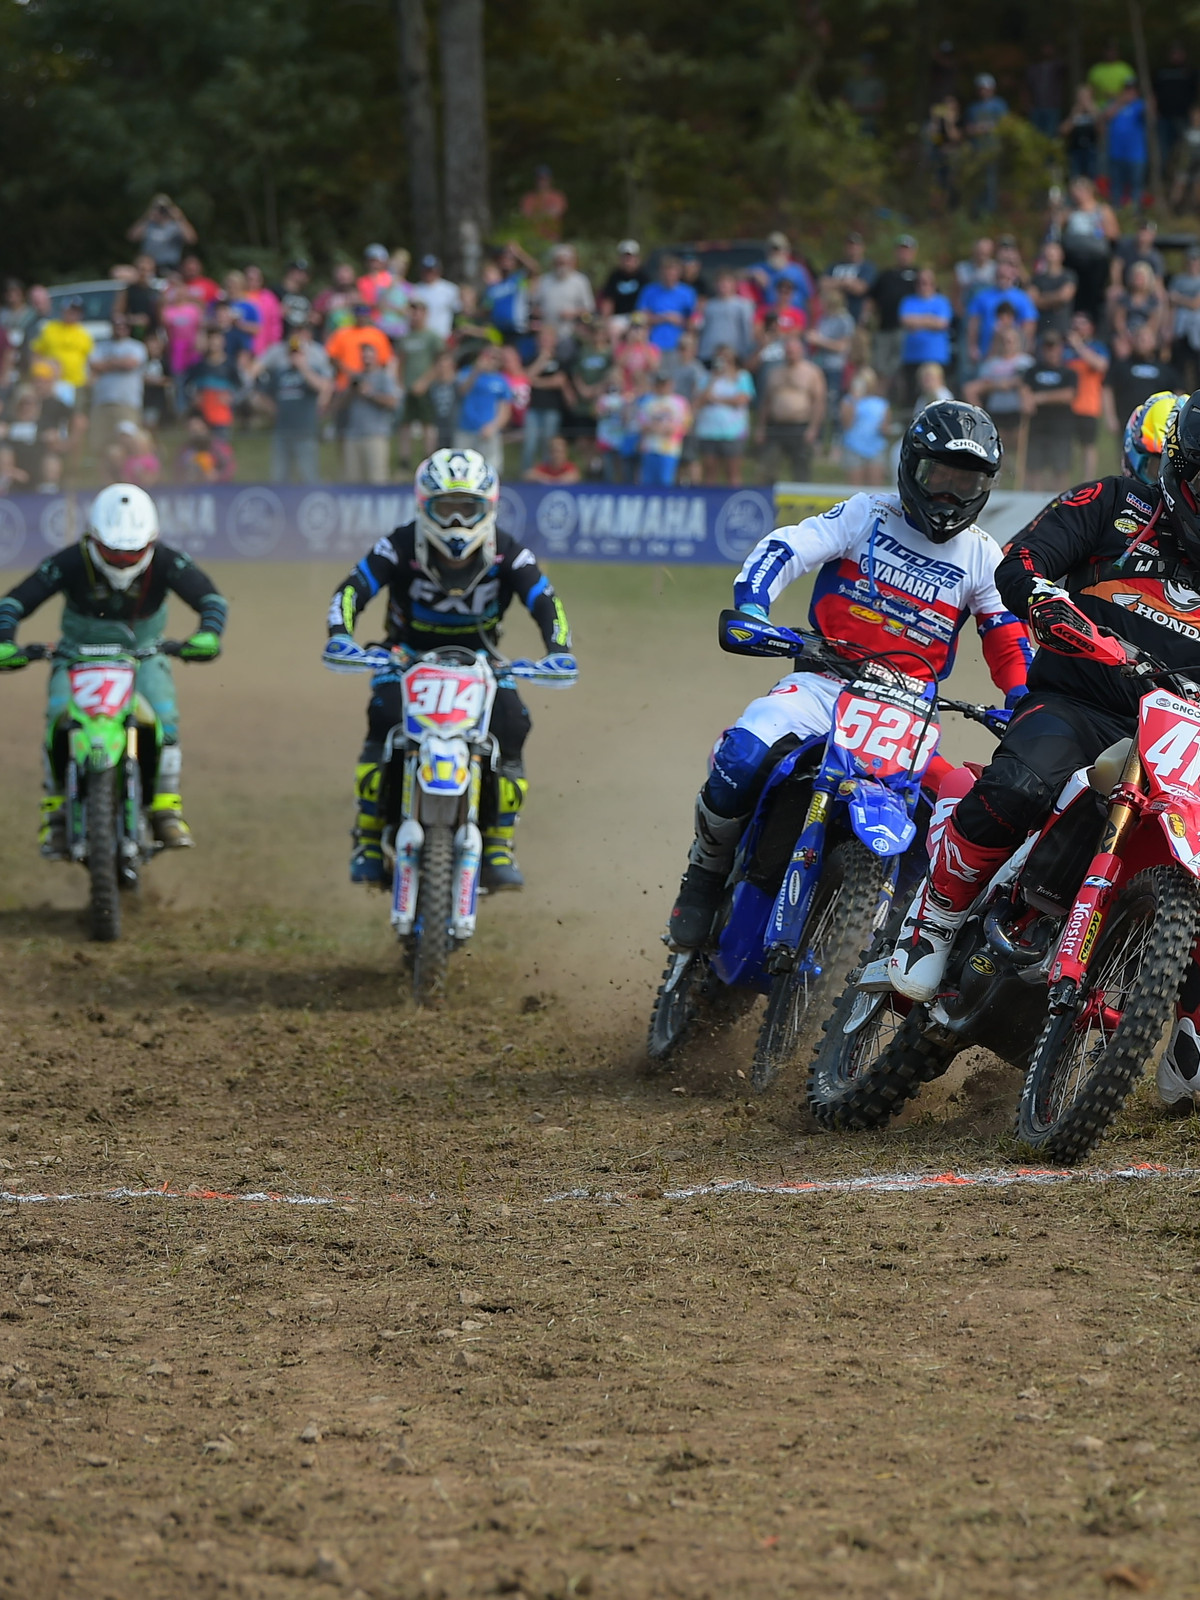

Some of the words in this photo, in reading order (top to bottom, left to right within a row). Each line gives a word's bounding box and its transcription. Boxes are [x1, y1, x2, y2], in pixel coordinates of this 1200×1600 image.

[953, 440, 983, 453] SHOEI
[577, 494, 707, 542] YAMAHA
[867, 530, 968, 582] MOOSE
[874, 560, 938, 604] YAMAHA
[901, 563, 961, 590] RACING
[767, 639, 791, 649] CYCRA
[1054, 627, 1096, 653] ACERBIS
[71, 669, 134, 709] 27
[407, 678, 488, 718] 314
[834, 697, 939, 772] 523
[1080, 912, 1100, 960] ACERBIS
